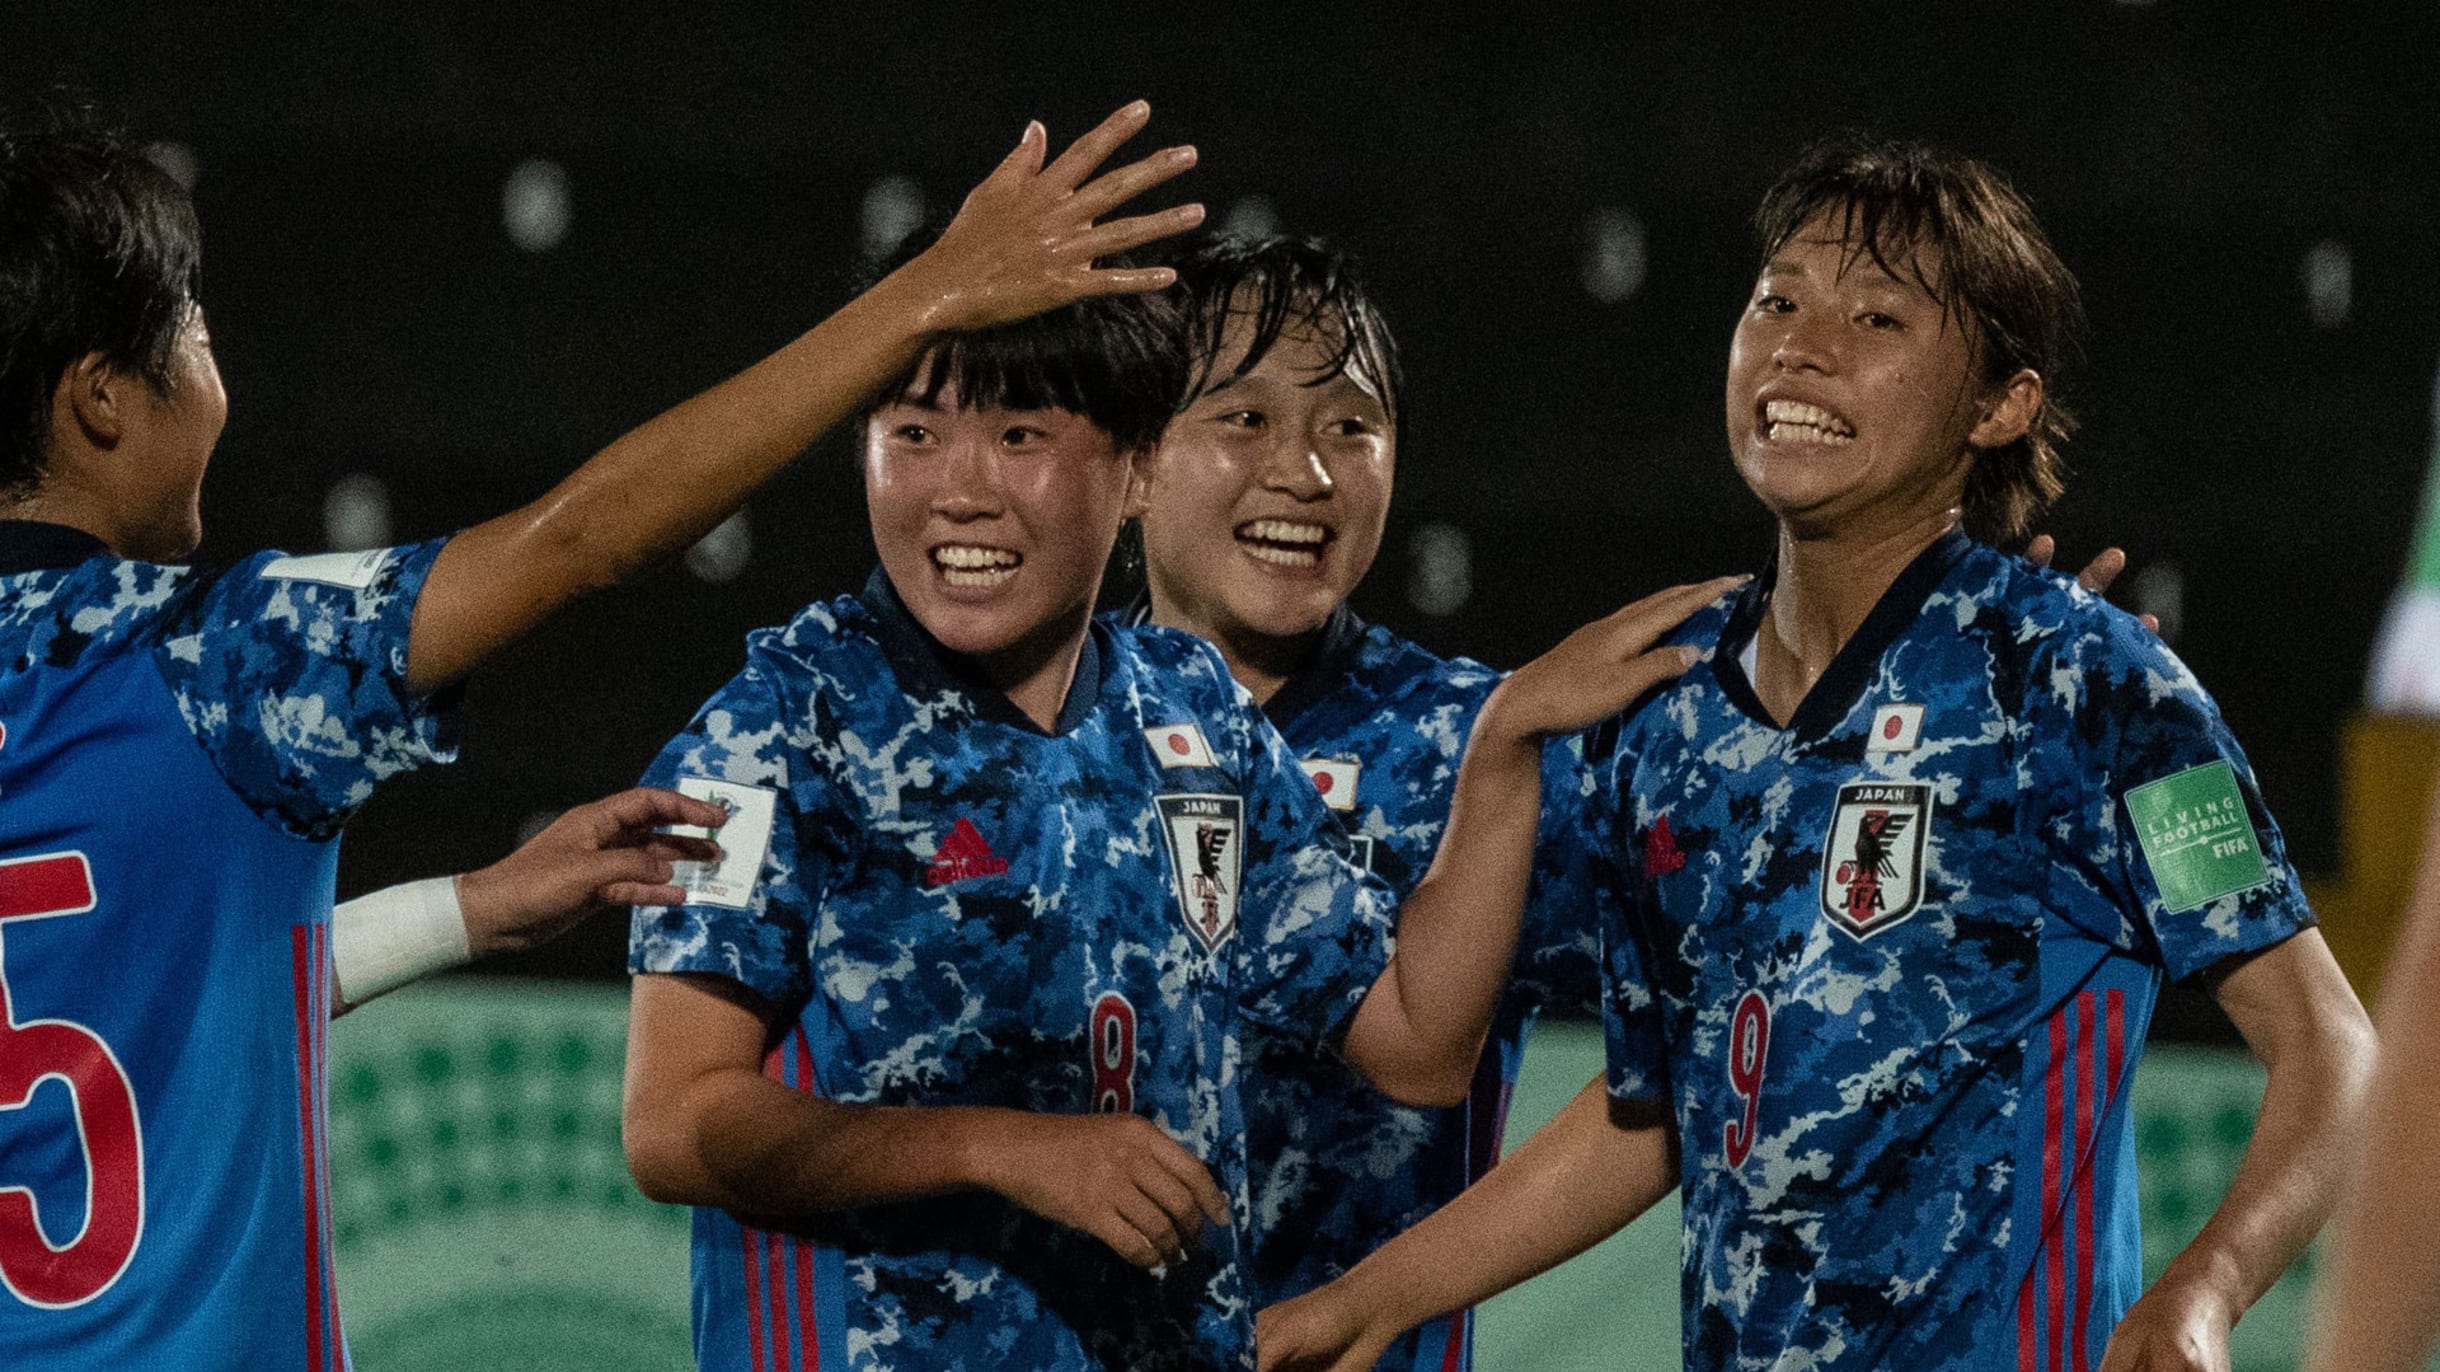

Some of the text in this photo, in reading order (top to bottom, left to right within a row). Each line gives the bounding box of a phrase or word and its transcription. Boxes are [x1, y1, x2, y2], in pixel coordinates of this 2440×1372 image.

[1183, 801, 1221, 814] JAPAN
[1855, 788, 1905, 801] JAPAN
[2148, 797, 2234, 836] LIVING
[2152, 812, 2238, 848] FOOTBALL
[2212, 837, 2248, 859] FIFA
[1838, 887, 1886, 910] JFA
[1090, 990, 1137, 1114] 8
[0, 850, 145, 1310] 5
[1724, 988, 1772, 1172] 9
